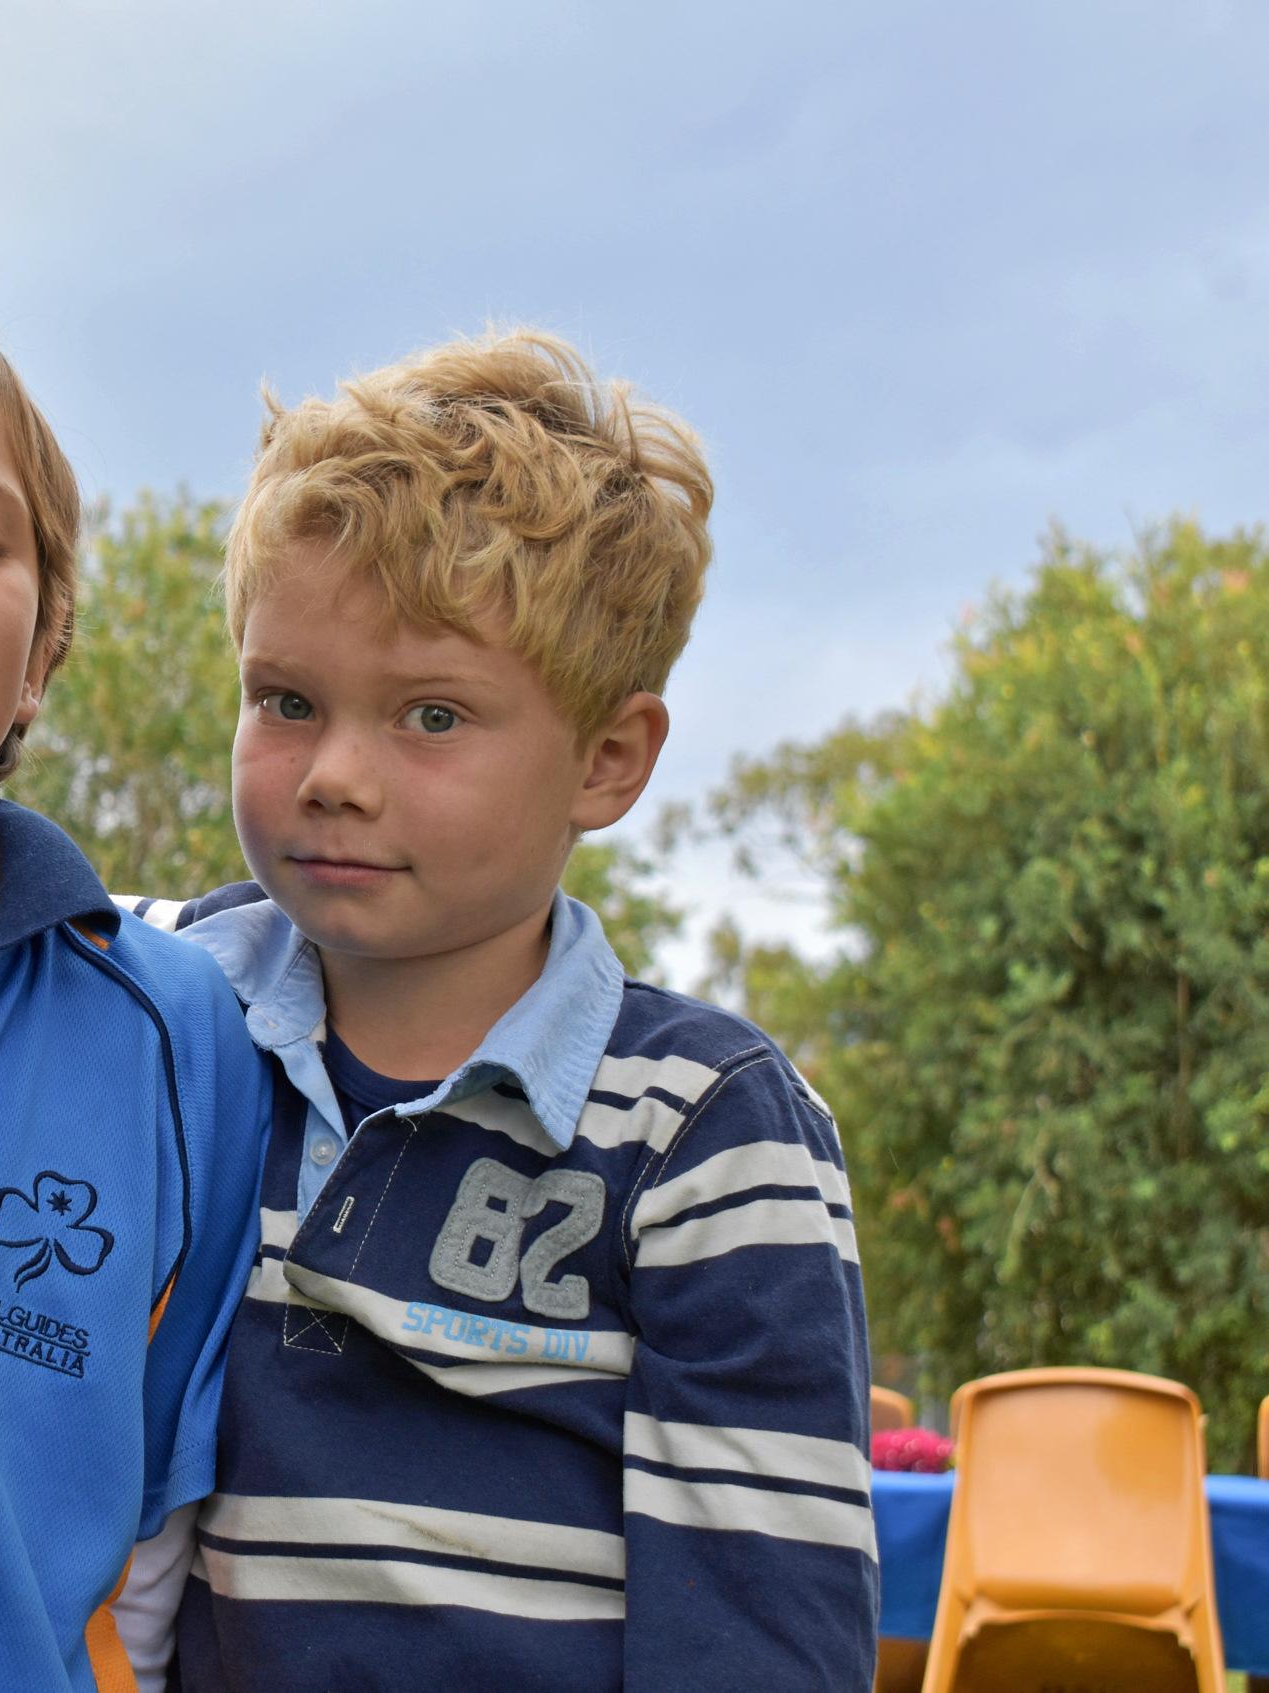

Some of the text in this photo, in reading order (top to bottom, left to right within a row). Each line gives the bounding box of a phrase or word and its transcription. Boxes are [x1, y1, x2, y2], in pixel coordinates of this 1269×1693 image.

[428, 1157, 606, 1320] 82
[6, 1305, 89, 1350] GUIDES
[402, 1301, 597, 1362] SPORTS DIV.
